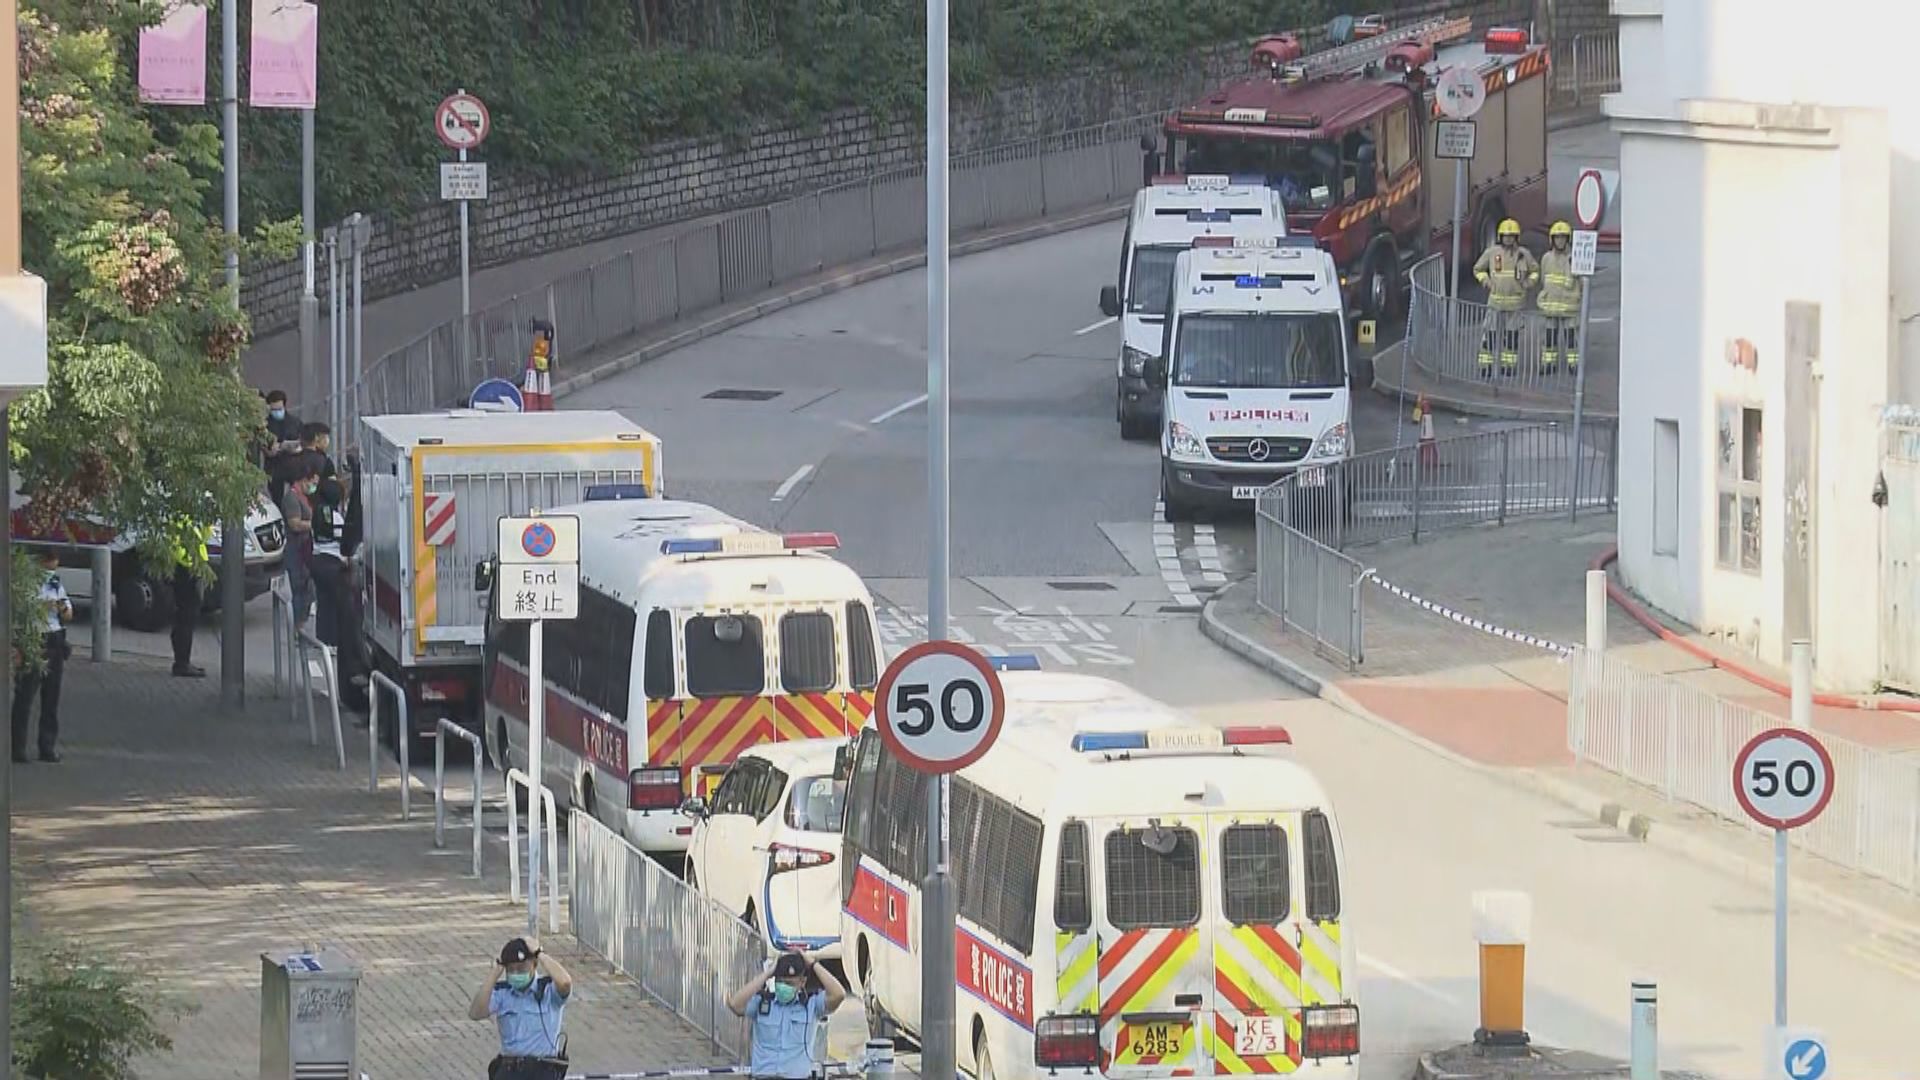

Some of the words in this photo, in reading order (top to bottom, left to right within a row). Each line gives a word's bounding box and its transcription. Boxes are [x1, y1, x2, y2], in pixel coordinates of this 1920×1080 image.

[1229, 409, 1293, 420] POLICE
[1236, 488, 1251, 497] AM
[523, 570, 557, 584] End
[515, 590, 563, 613] 終止
[896, 678, 984, 737] 50
[1752, 760, 1815, 797] 50
[982, 951, 1014, 1011] POLICE
[1145, 1025, 1168, 1041] AM
[1246, 1020, 1272, 1036] KE
[1133, 1040, 1179, 1055] 6283
[1242, 1035, 1277, 1051] 2/3
